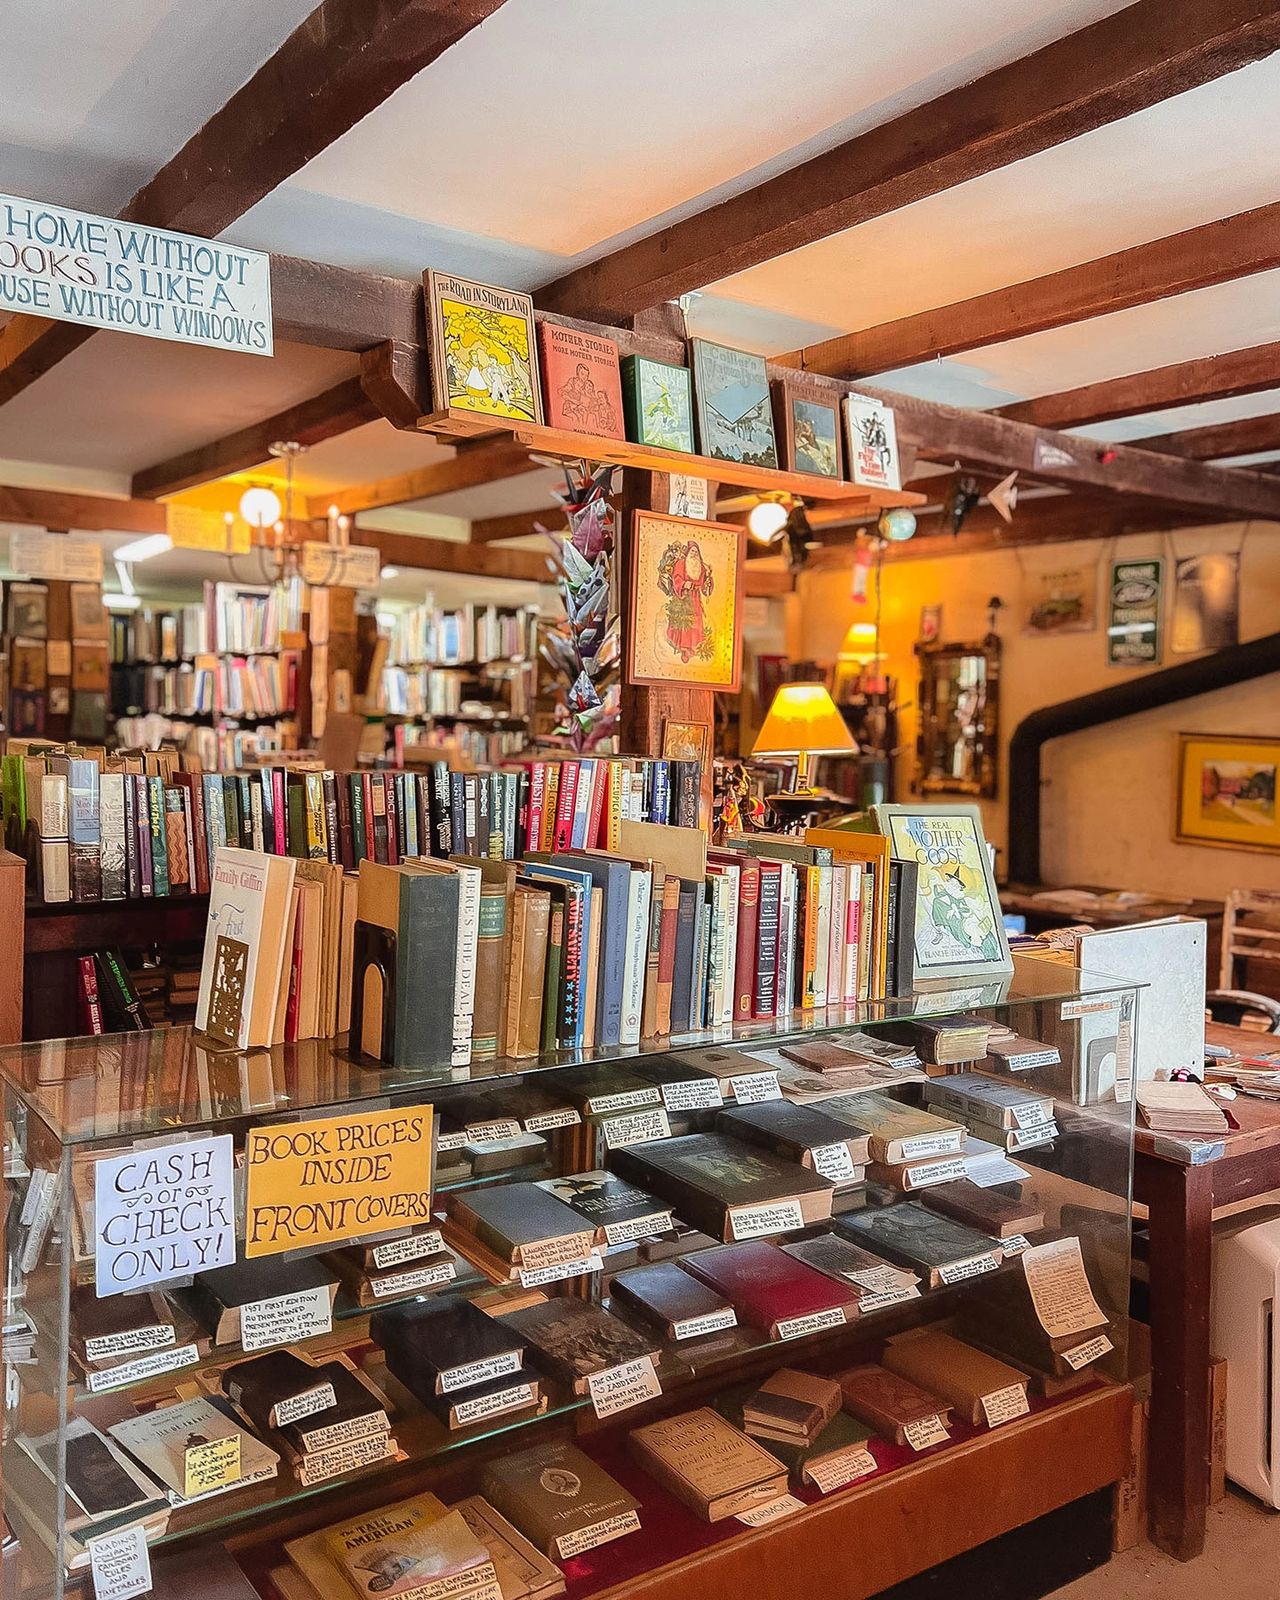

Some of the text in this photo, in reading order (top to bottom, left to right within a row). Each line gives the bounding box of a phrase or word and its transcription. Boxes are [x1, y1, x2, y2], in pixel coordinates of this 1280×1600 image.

[4, 205, 252, 286] HOME WITHOUT
[106, 262, 133, 294] IS
[140, 269, 203, 307] LIKE
[210, 284, 239, 313] A
[437, 279, 528, 316] THE ROAD IN STORYLAND
[0, 275, 266, 349] USE WITHOUT WINDOWS
[551, 329, 614, 355] MOTHER STORIES
[552, 344, 616, 368] MORE MOTHER STORIES
[387, 790, 395, 814] EDICT
[531, 767, 544, 812] MAJESTIC
[549, 790, 558, 808] Loo
[564, 764, 577, 821] MICHAEL CRICHTON
[612, 786, 620, 813] LUPICA
[653, 768, 667, 815] Tom Clancy
[354, 785, 362, 824] Driftglass
[531, 814, 540, 835] WHITLEY
[544, 807, 556, 848] Sanction
[914, 821, 952, 830] THE REAL
[908, 830, 966, 847] MOTHER
[915, 847, 966, 865] GOOSE
[215, 866, 263, 892] Emily Giffin
[464, 872, 477, 927] HERE'S
[462, 931, 474, 964] THE
[566, 898, 577, 982] NOR SAFETY
[109, 960, 125, 989] STEPHEN
[630, 978, 639, 1009] Medicine
[250, 1117, 423, 1165] BOOK PRICES
[114, 1150, 215, 1194] CASH
[299, 1153, 392, 1187] INSIDE
[158, 1186, 182, 1204] or
[100, 1196, 232, 1247] CHECK
[250, 1192, 430, 1245] FRONT COVERS
[111, 1233, 223, 1282] ONLY!
[522, 1243, 555, 1255] LANCASTER
[522, 1250, 554, 1261] CAMERON
[526, 1259, 547, 1269] EMILY
[245, 1305, 305, 1323] AUTHOR SIGNED
[264, 1294, 319, 1311] FIRST EDITION
[244, 1312, 316, 1331] PRESENTATION COPY
[267, 1325, 286, 1336] HERE
[245, 1329, 312, 1349] BY JAMES JONES
[625, 1363, 643, 1375] FIRE
[649, 1414, 701, 1436] No man
[651, 1420, 716, 1449] knows my
[671, 1430, 717, 1452] history
[744, 1499, 794, 1525] MORMON
[344, 1519, 416, 1550] AMERICAN
[355, 1517, 392, 1534] TALL
